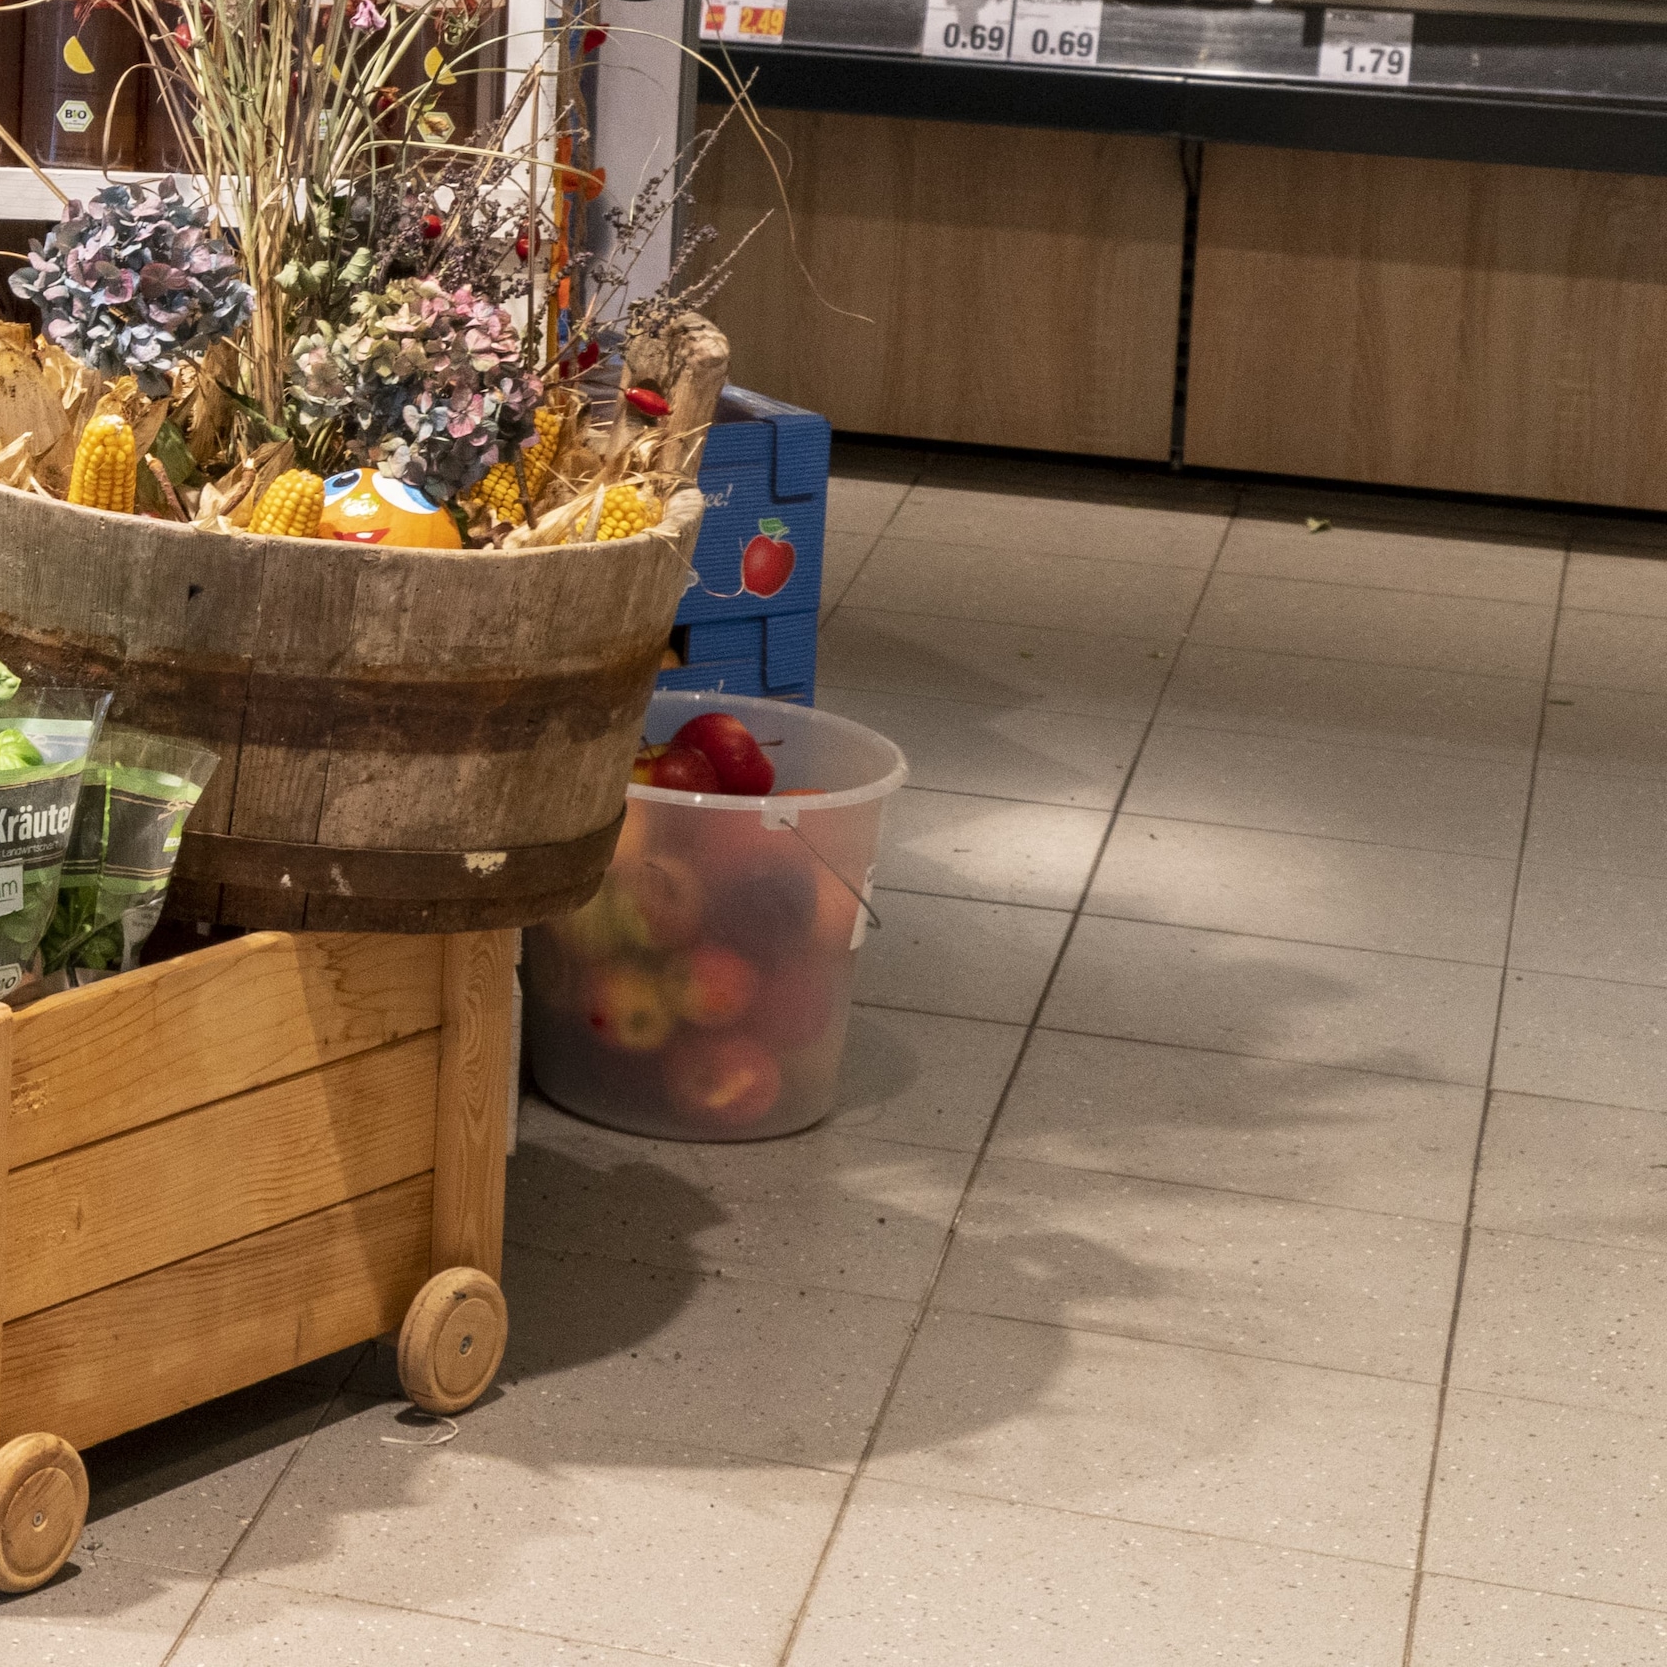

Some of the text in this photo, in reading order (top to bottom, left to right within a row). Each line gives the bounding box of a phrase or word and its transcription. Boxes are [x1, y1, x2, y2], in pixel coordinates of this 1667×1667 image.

[739, 7, 786, 35] 2.49
[943, 22, 1005, 52] 0.69
[1031, 28, 1095, 58] 0.69
[1342, 46, 1405, 75] 1.79
